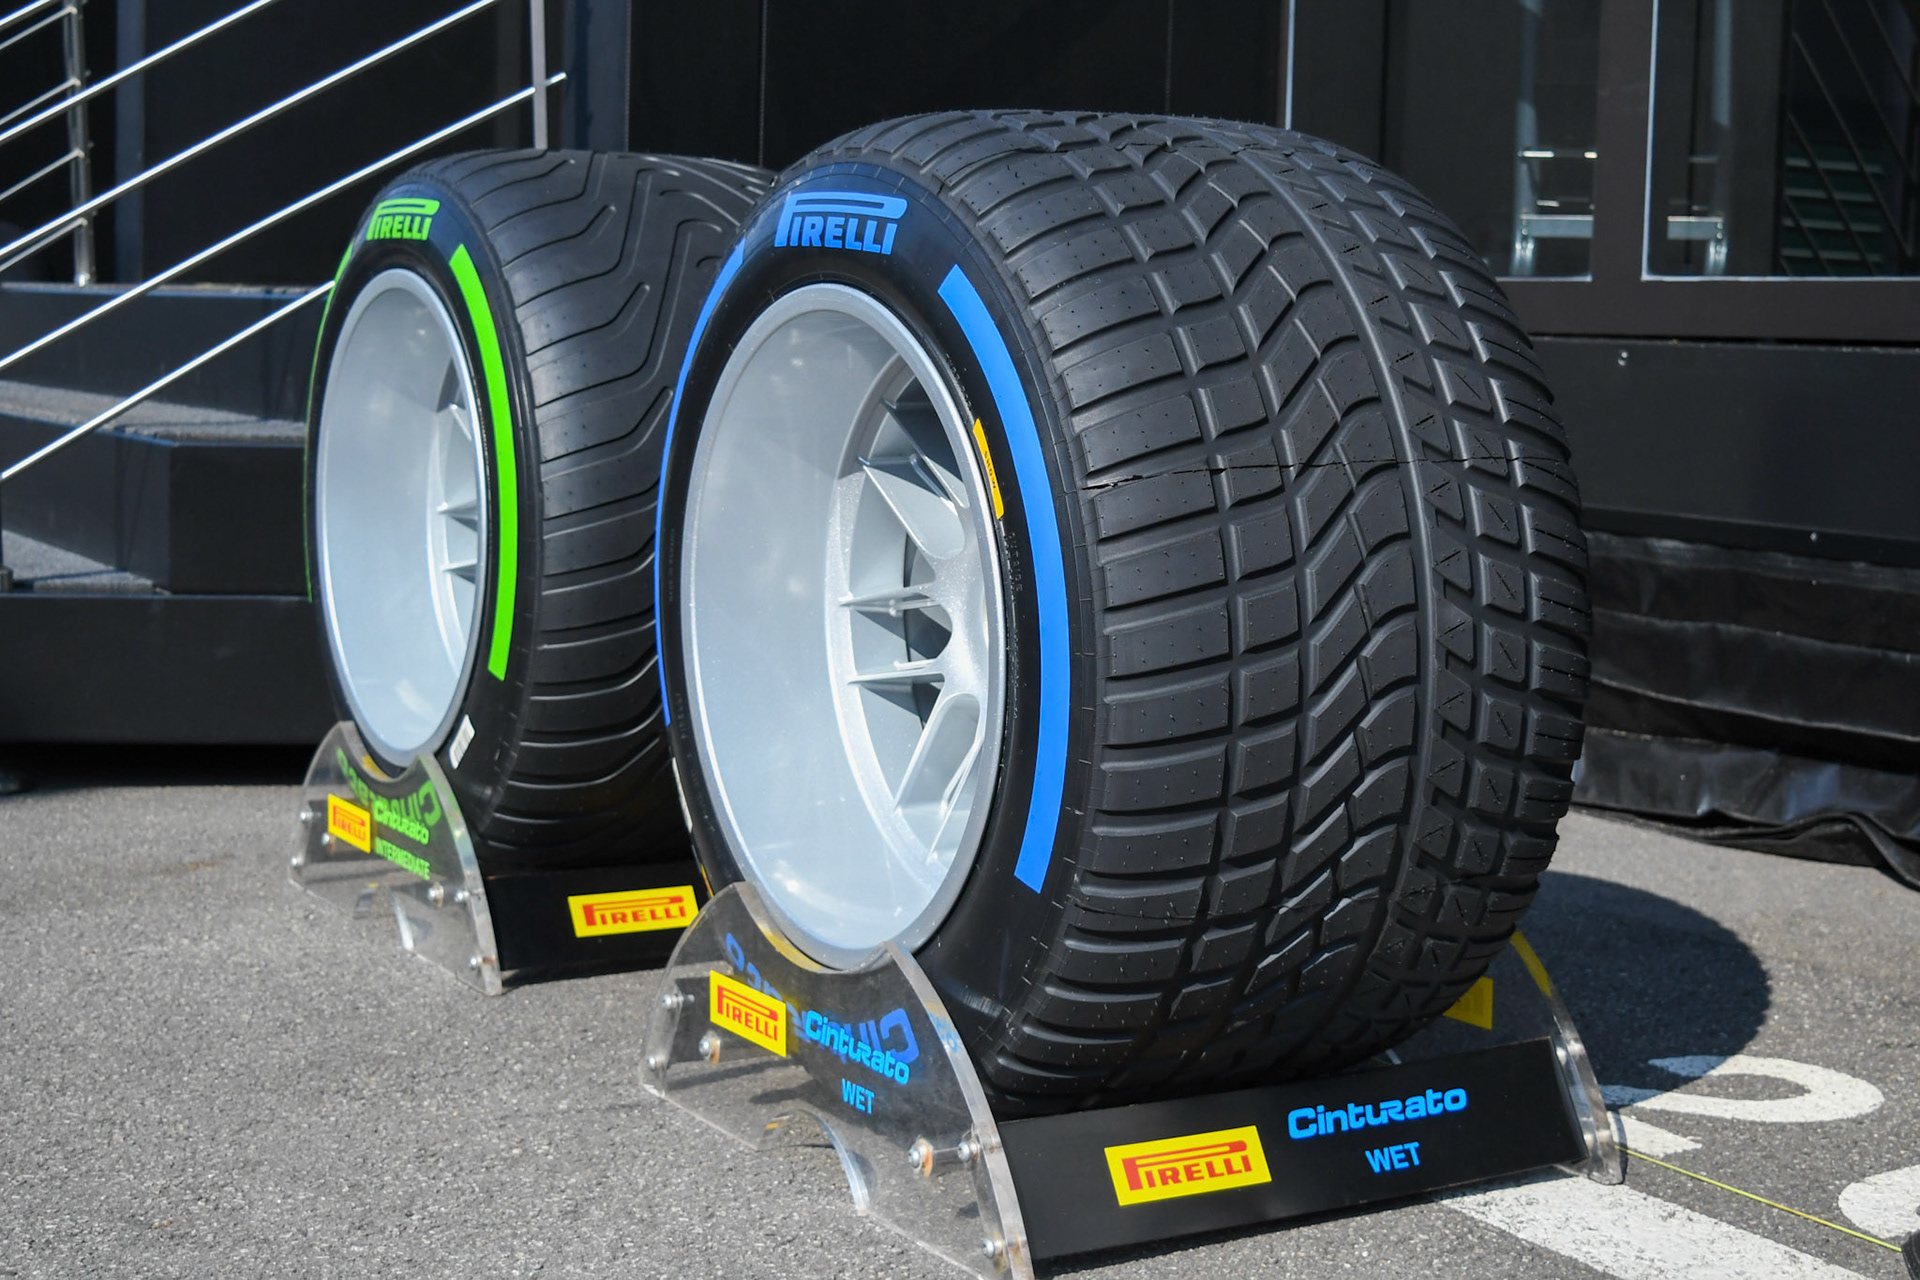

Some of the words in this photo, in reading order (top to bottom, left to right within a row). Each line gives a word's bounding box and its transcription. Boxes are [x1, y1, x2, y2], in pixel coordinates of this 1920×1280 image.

[366, 198, 441, 241] PIRELLI
[774, 191, 908, 255] PIRELLI
[333, 805, 367, 842] PIRELLI
[375, 837, 431, 881] INTERMEDIATE
[582, 896, 686, 927] PIRELLI
[717, 984, 779, 1042] PIRELLI
[805, 1010, 911, 1085] Cinturato
[841, 1078, 876, 1115] WET
[1287, 1087, 1468, 1139] Cinturato
[1121, 1139, 1253, 1191] PIRELLI
[1365, 1141, 1420, 1174] WET
